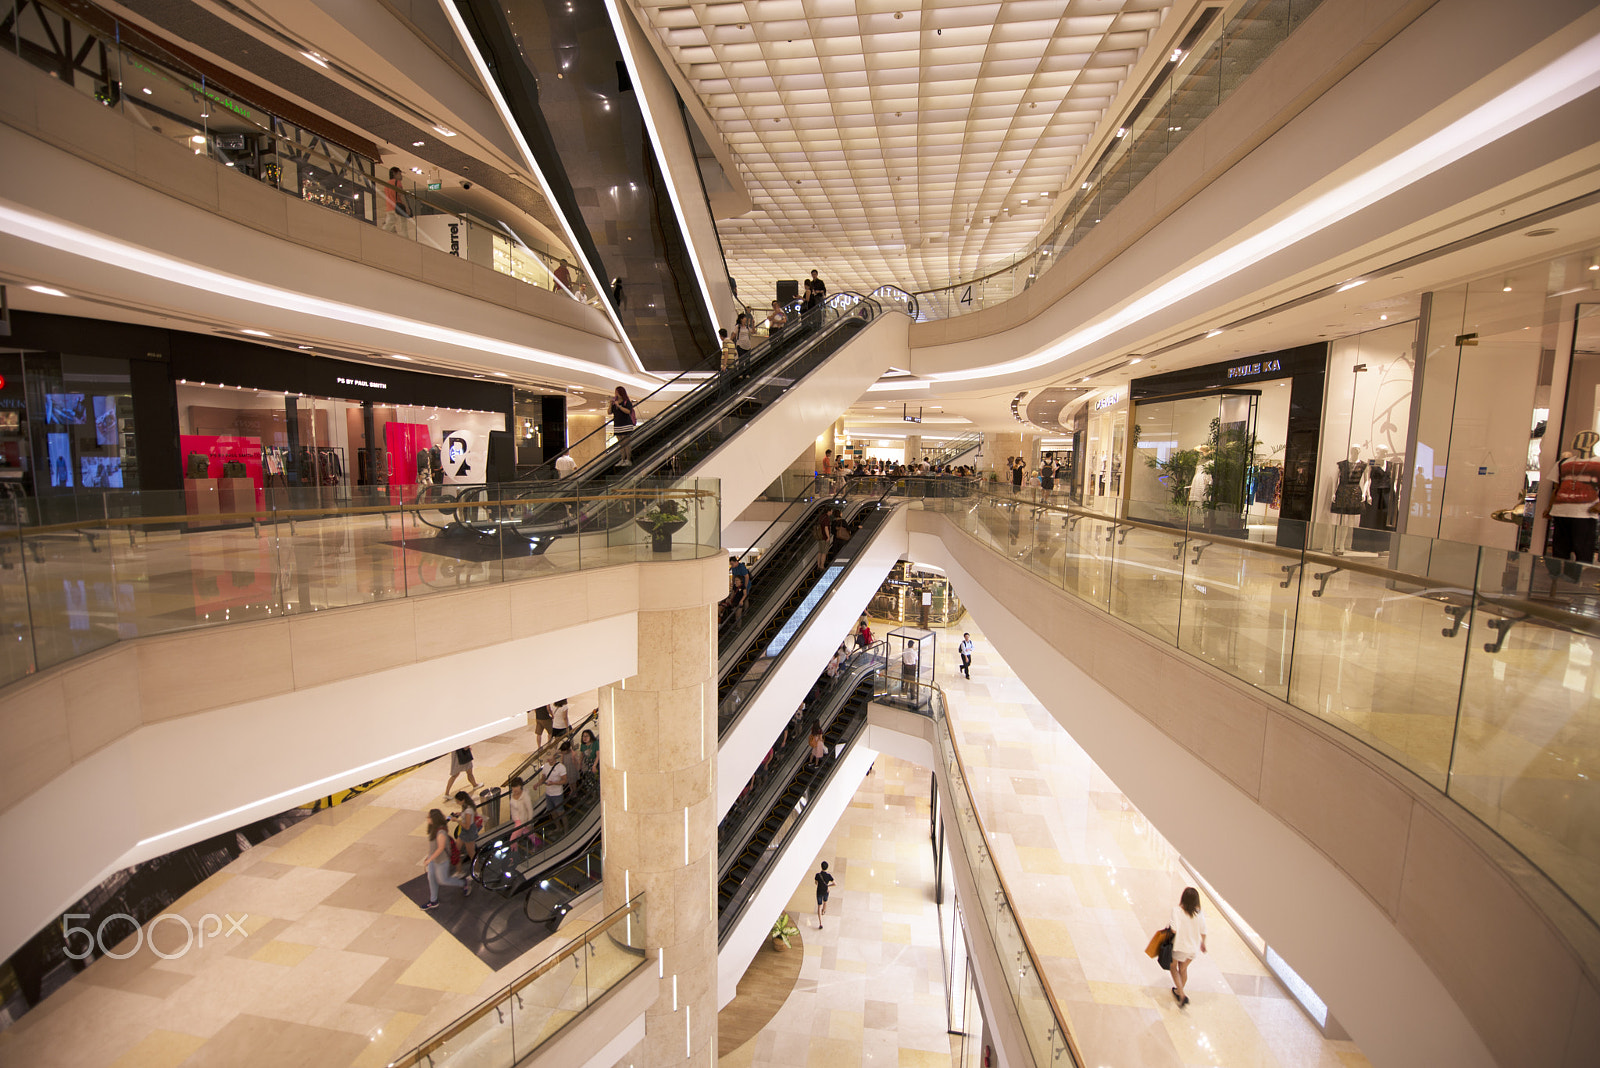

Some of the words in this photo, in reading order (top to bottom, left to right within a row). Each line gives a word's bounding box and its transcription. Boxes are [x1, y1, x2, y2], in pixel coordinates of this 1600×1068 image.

[960, 285, 973, 306] 4
[1228, 363, 1261, 378] PAULE
[1263, 360, 1281, 372] KA
